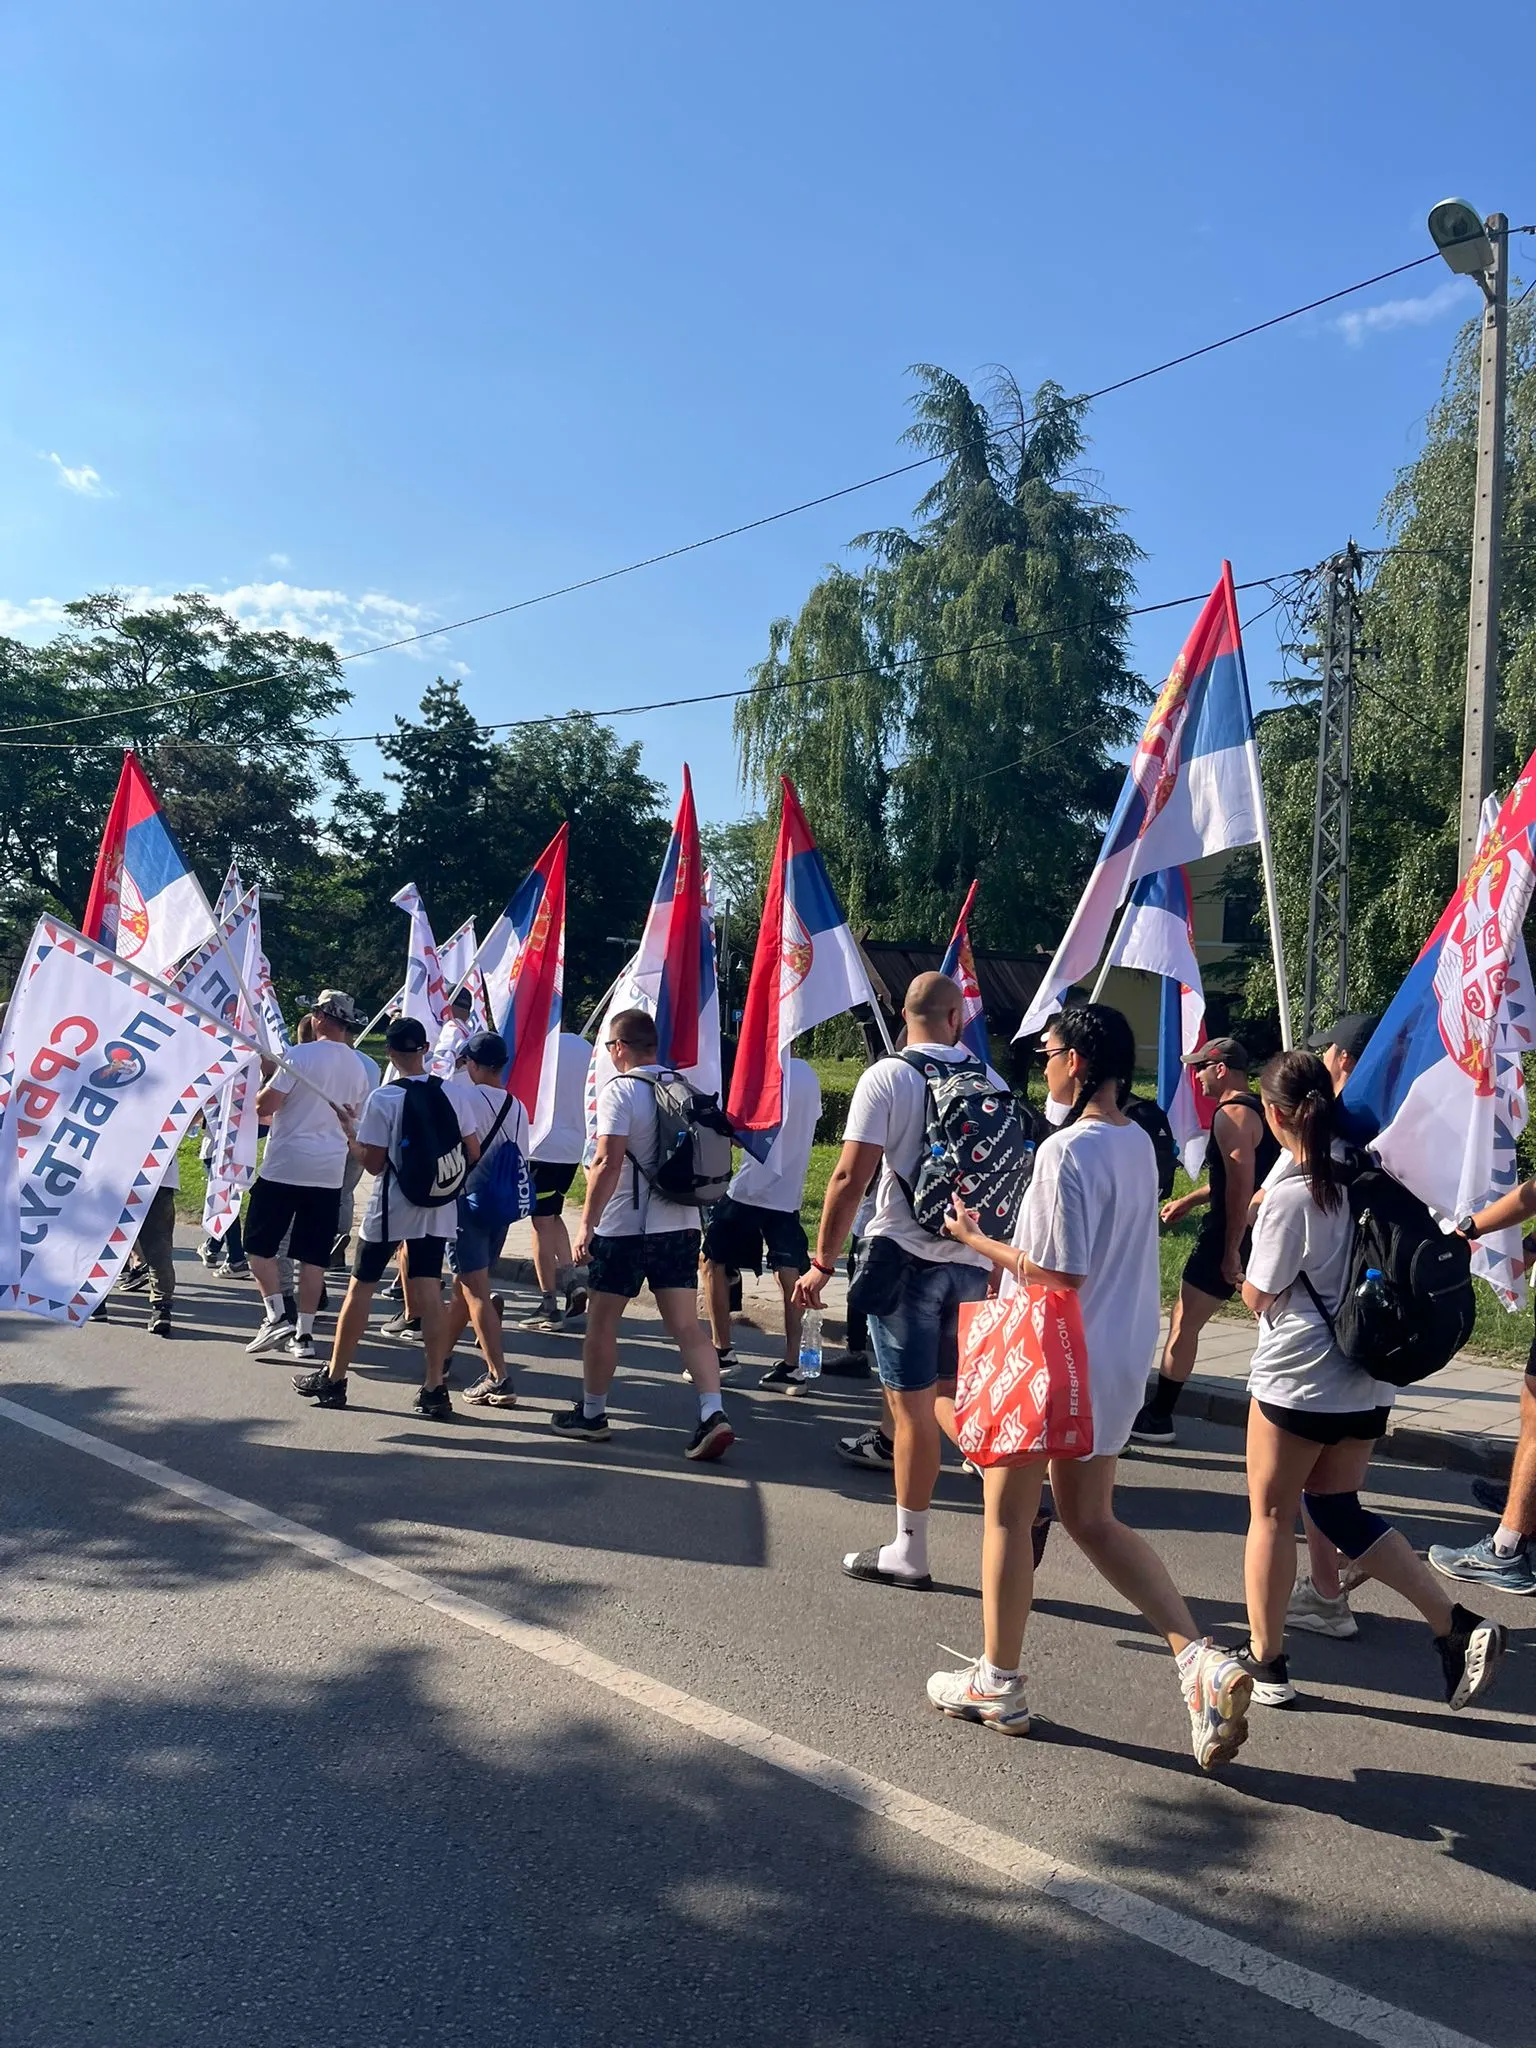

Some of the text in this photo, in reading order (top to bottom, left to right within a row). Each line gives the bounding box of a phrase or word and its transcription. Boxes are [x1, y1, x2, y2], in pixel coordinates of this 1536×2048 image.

[437, 1141, 463, 1184] NIK
[990, 1348, 1029, 1411] BSK
[1056, 1317, 1079, 1416] BERSHKA.COM
[960, 1415, 984, 1453] SK
